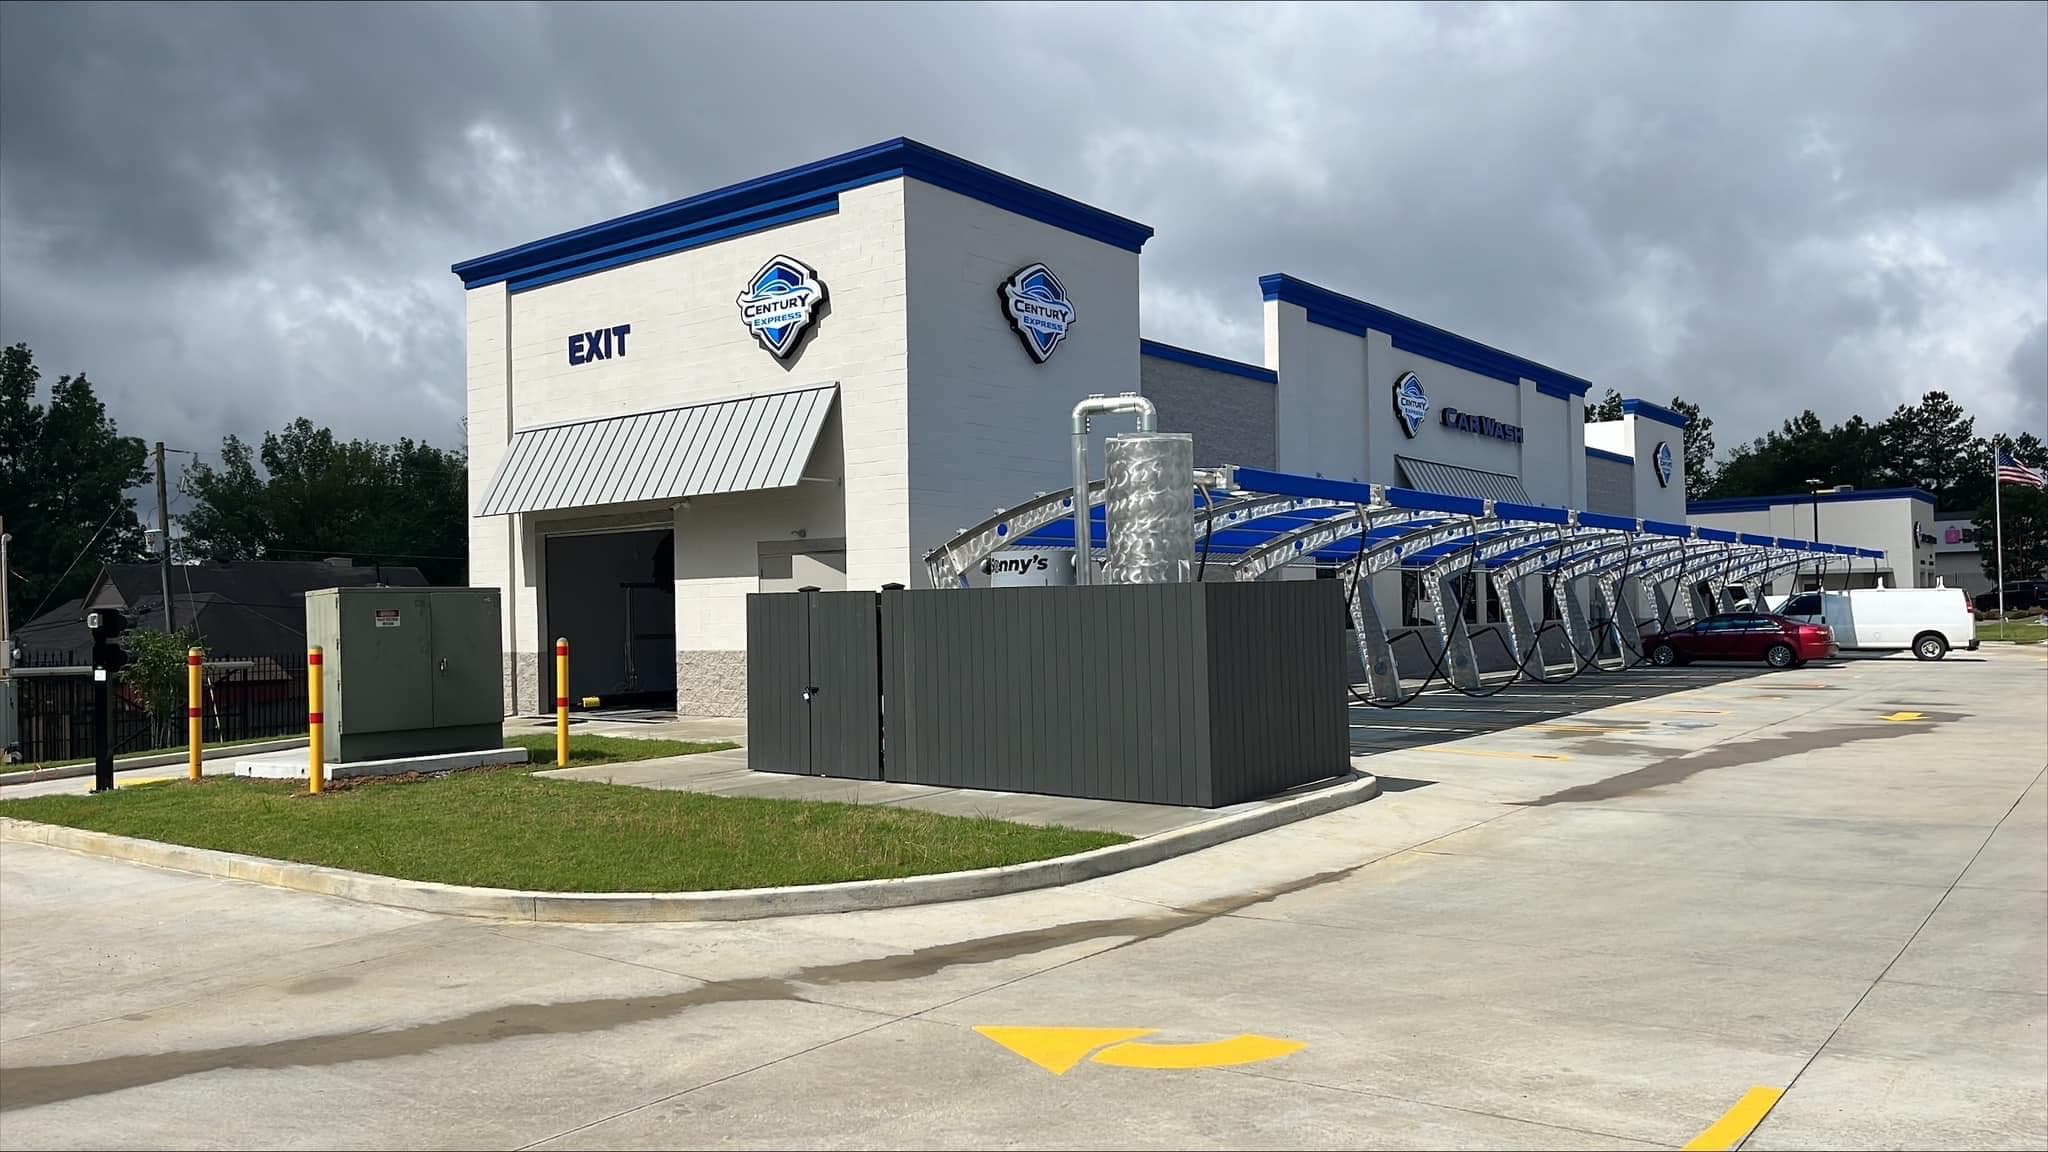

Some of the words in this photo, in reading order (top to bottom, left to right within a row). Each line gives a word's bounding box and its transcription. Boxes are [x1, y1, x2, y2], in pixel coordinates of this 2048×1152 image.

[744, 293, 810, 318] CENTURY
[1014, 299, 1069, 323] CENTURY
[753, 311, 802, 327] EXPRESS
[1023, 315, 1063, 332] EXPRESS
[568, 324, 631, 366] EXIT
[1442, 407, 1481, 434] CAR
[1481, 416, 1524, 443] WASH
